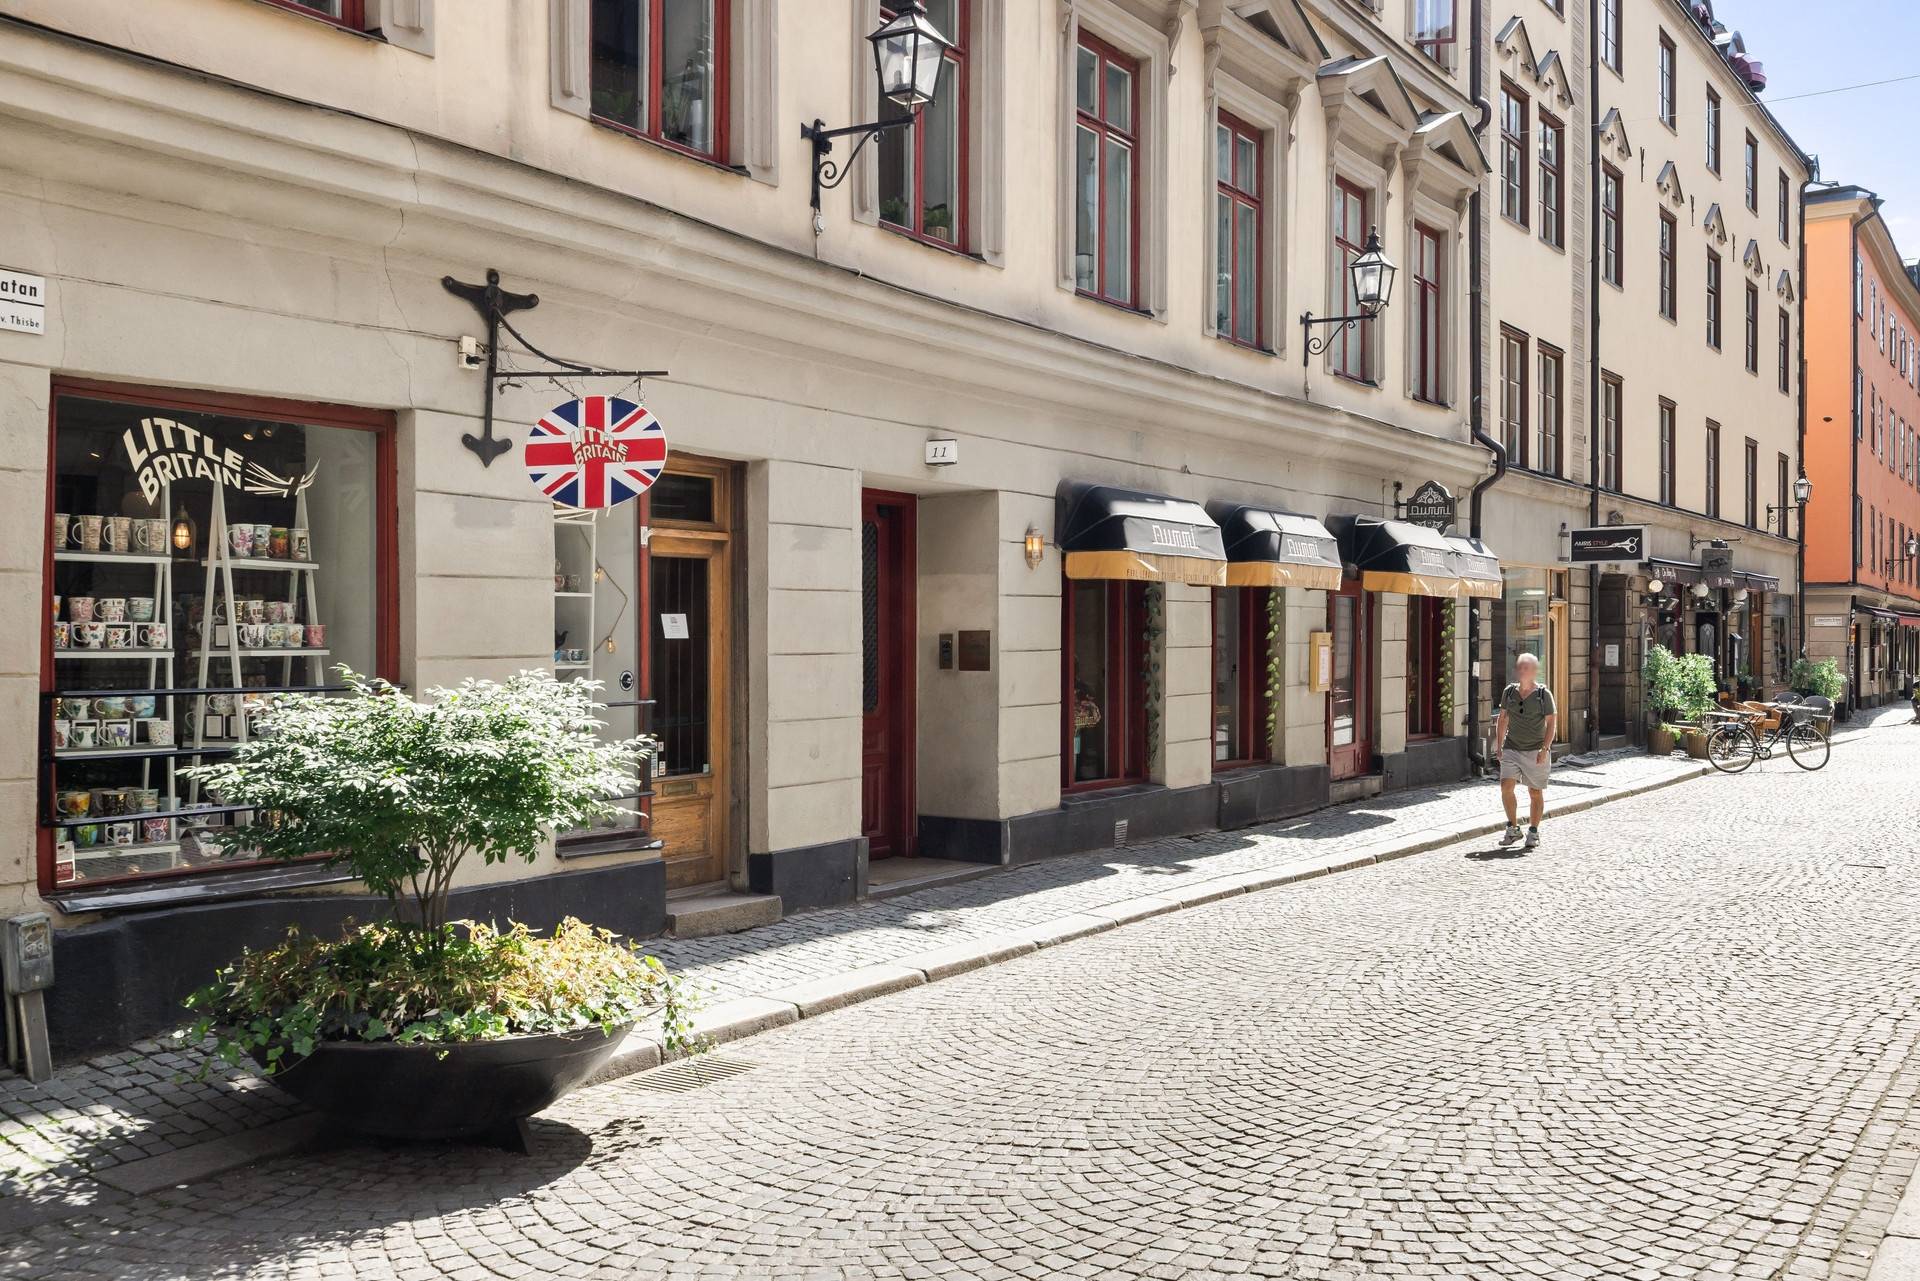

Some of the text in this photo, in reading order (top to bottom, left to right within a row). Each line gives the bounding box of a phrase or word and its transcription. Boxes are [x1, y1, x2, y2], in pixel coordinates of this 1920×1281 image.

[1, 280, 37, 297] atan
[11, 315, 40, 328] Thisbe
[123, 417, 244, 472] LITTLE
[570, 425, 628, 455] LITTLE
[932, 446, 946, 458] 11
[574, 445, 626, 471] BRITAIN
[138, 453, 241, 505] BRITAIN
